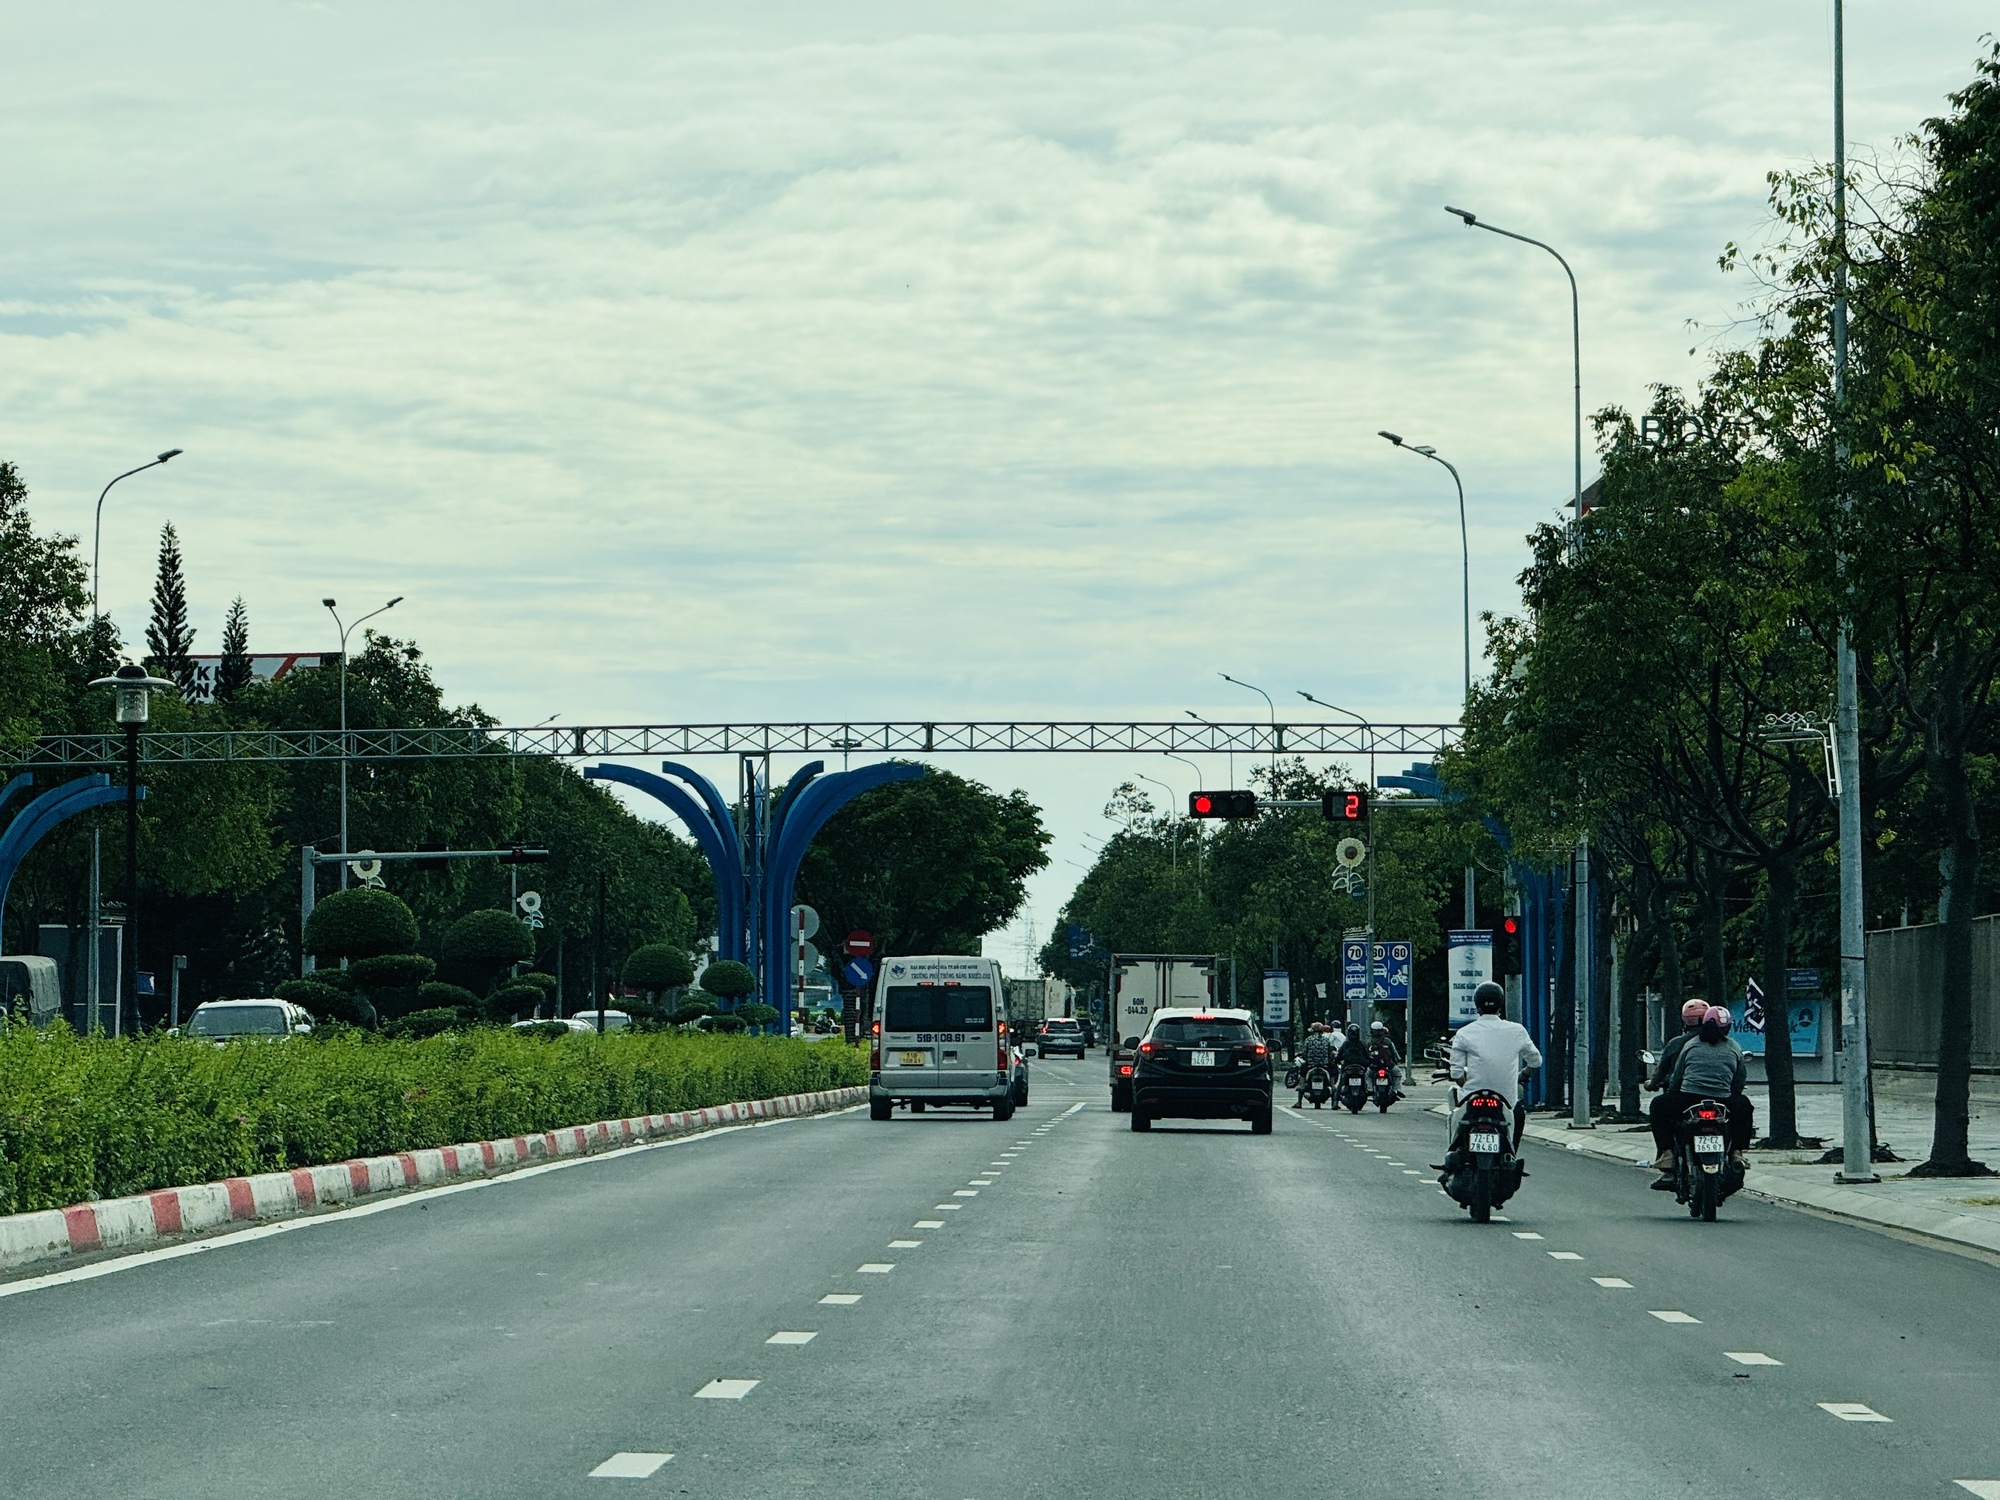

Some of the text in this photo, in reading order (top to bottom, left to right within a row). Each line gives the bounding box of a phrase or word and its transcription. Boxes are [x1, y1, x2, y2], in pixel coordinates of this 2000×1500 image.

[1641, 416, 1726, 446] BDV
[1345, 795, 1358, 818] 2
[1350, 949, 1361, 958] 70
[1394, 948, 1406, 957] 60
